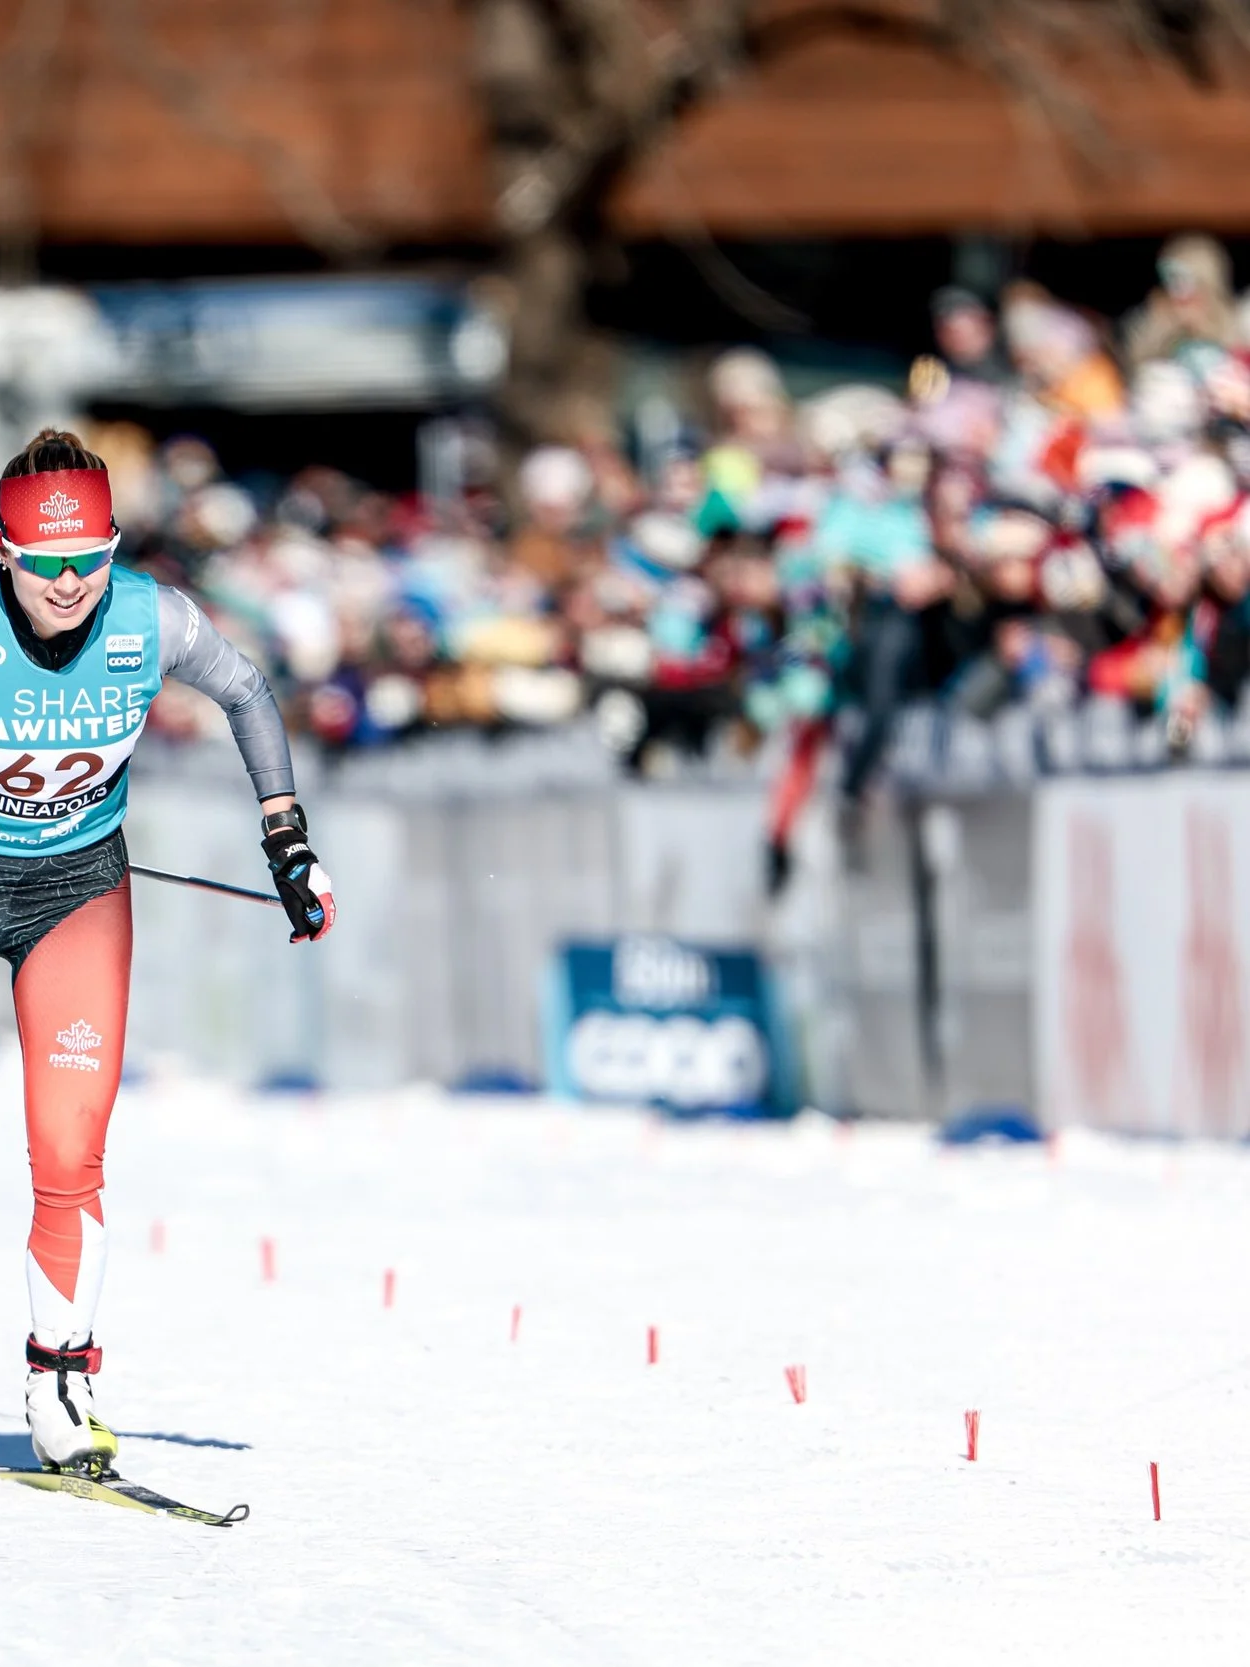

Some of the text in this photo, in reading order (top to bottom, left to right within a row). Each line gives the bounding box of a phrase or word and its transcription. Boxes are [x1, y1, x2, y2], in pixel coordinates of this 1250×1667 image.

[38, 518, 84, 532] nordiq
[108, 656, 142, 667] coop
[13, 683, 145, 716] SHARE
[11, 708, 142, 742] WINTER
[48, 1053, 100, 1072] nordiq
[60, 1477, 93, 1497] FISCHER
